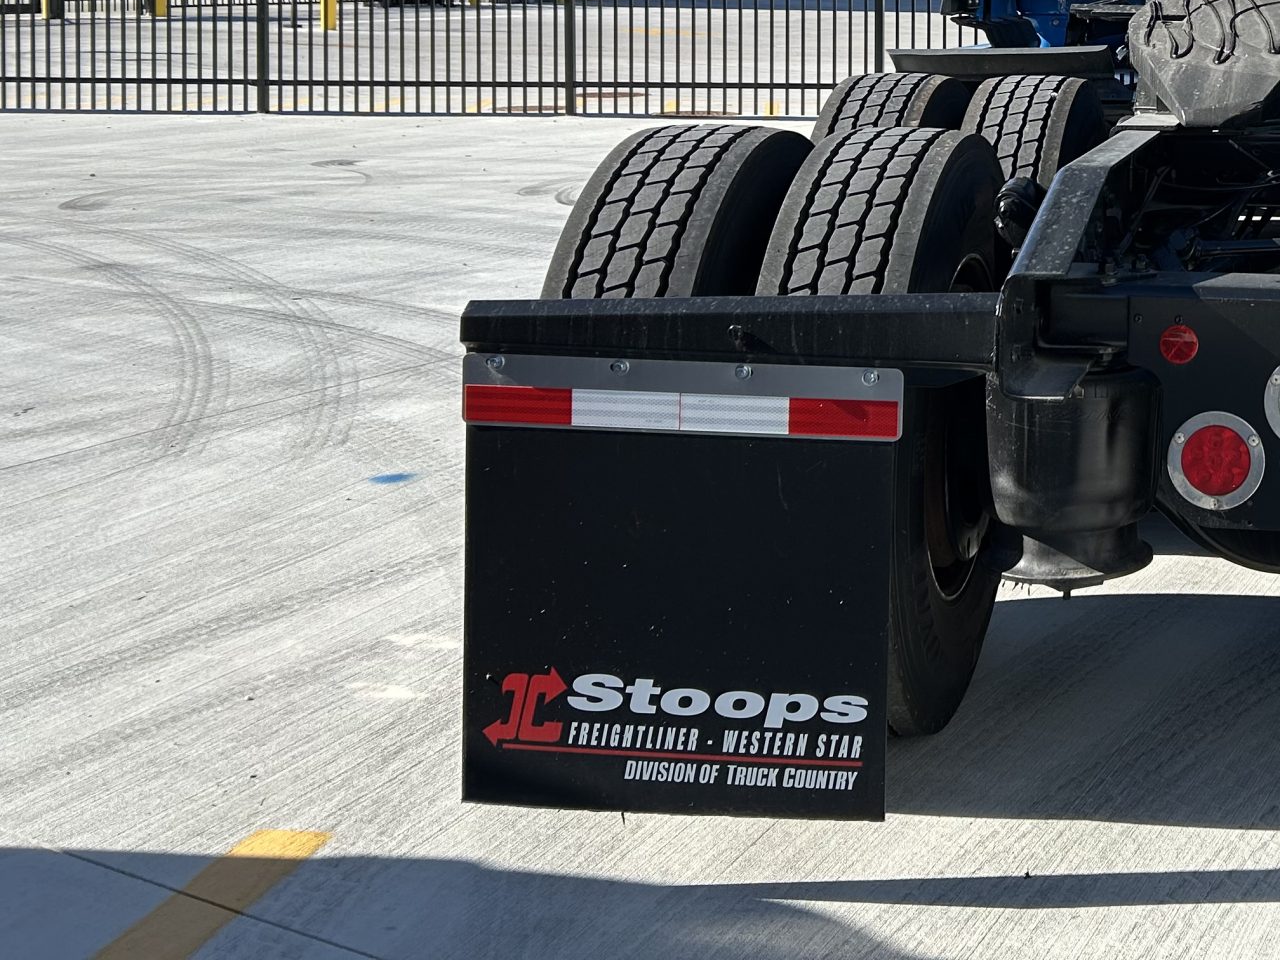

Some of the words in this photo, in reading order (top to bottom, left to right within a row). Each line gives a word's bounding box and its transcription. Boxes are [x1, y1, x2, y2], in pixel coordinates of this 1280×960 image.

[567, 673, 869, 729] Stoops
[567, 721, 699, 752] FREIGHTLINER
[722, 729, 809, 757] WESTERN
[815, 733, 863, 759] STAR
[624, 760, 697, 784] DIVISION
[699, 763, 720, 784] OF
[726, 764, 780, 788] TRUCK
[782, 767, 858, 791] COUNTRY
